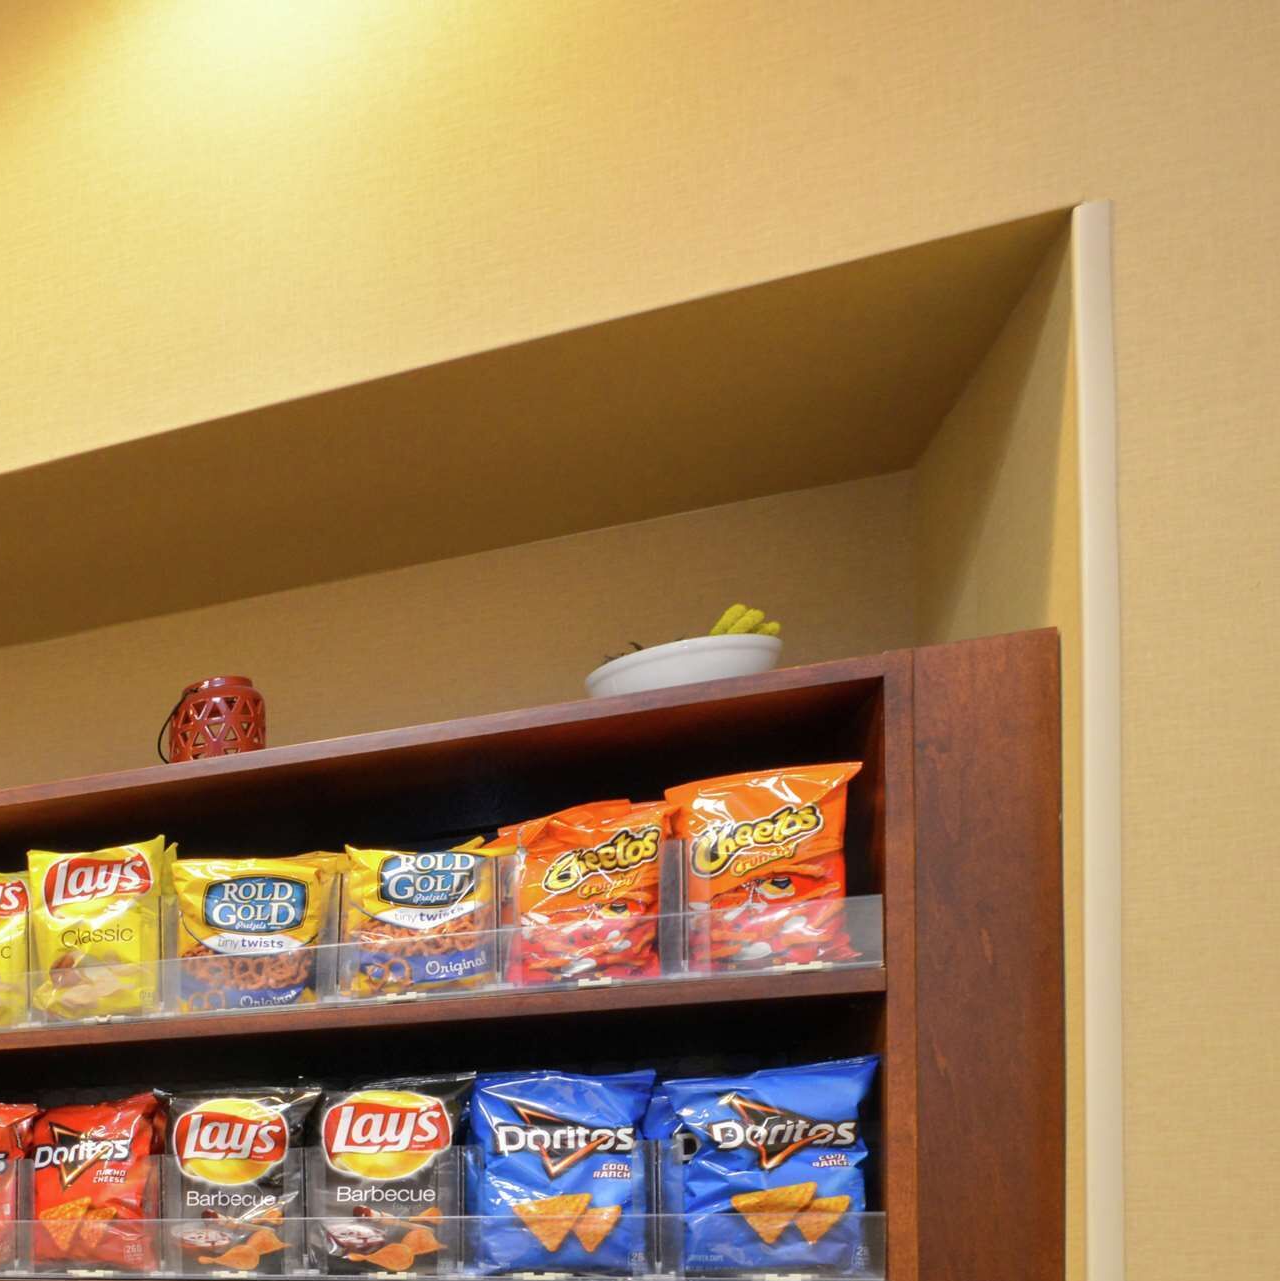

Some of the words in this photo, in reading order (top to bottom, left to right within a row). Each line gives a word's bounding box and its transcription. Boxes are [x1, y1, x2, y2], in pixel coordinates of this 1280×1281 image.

[690, 804, 825, 876] Cheetos
[399, 852, 476, 872] ROLD
[543, 827, 662, 892] Cheetos
[51, 855, 143, 907] Lay's
[221, 881, 294, 902] ROLD
[387, 872, 475, 901] GOLD
[212, 902, 296, 927] GOLD
[393, 911, 418, 923] tiny
[60, 925, 133, 949] Classic
[217, 937, 240, 950] tiny
[241, 937, 284, 949] twists
[425, 955, 487, 980] Original
[183, 1114, 285, 1160] Lay's
[332, 1106, 440, 1153] Lay's
[497, 1126, 634, 1152] Doritos
[711, 1120, 856, 1148] Doritos
[33, 1138, 130, 1169] Doritos
[95, 1169, 126, 1177] NACHO
[593, 1170, 631, 1179] RANCH
[602, 1163, 629, 1172] COOL
[92, 1176, 126, 1184] CHEESE
[186, 1191, 276, 1207] Barbecue
[337, 1186, 436, 1202] Barbecue
